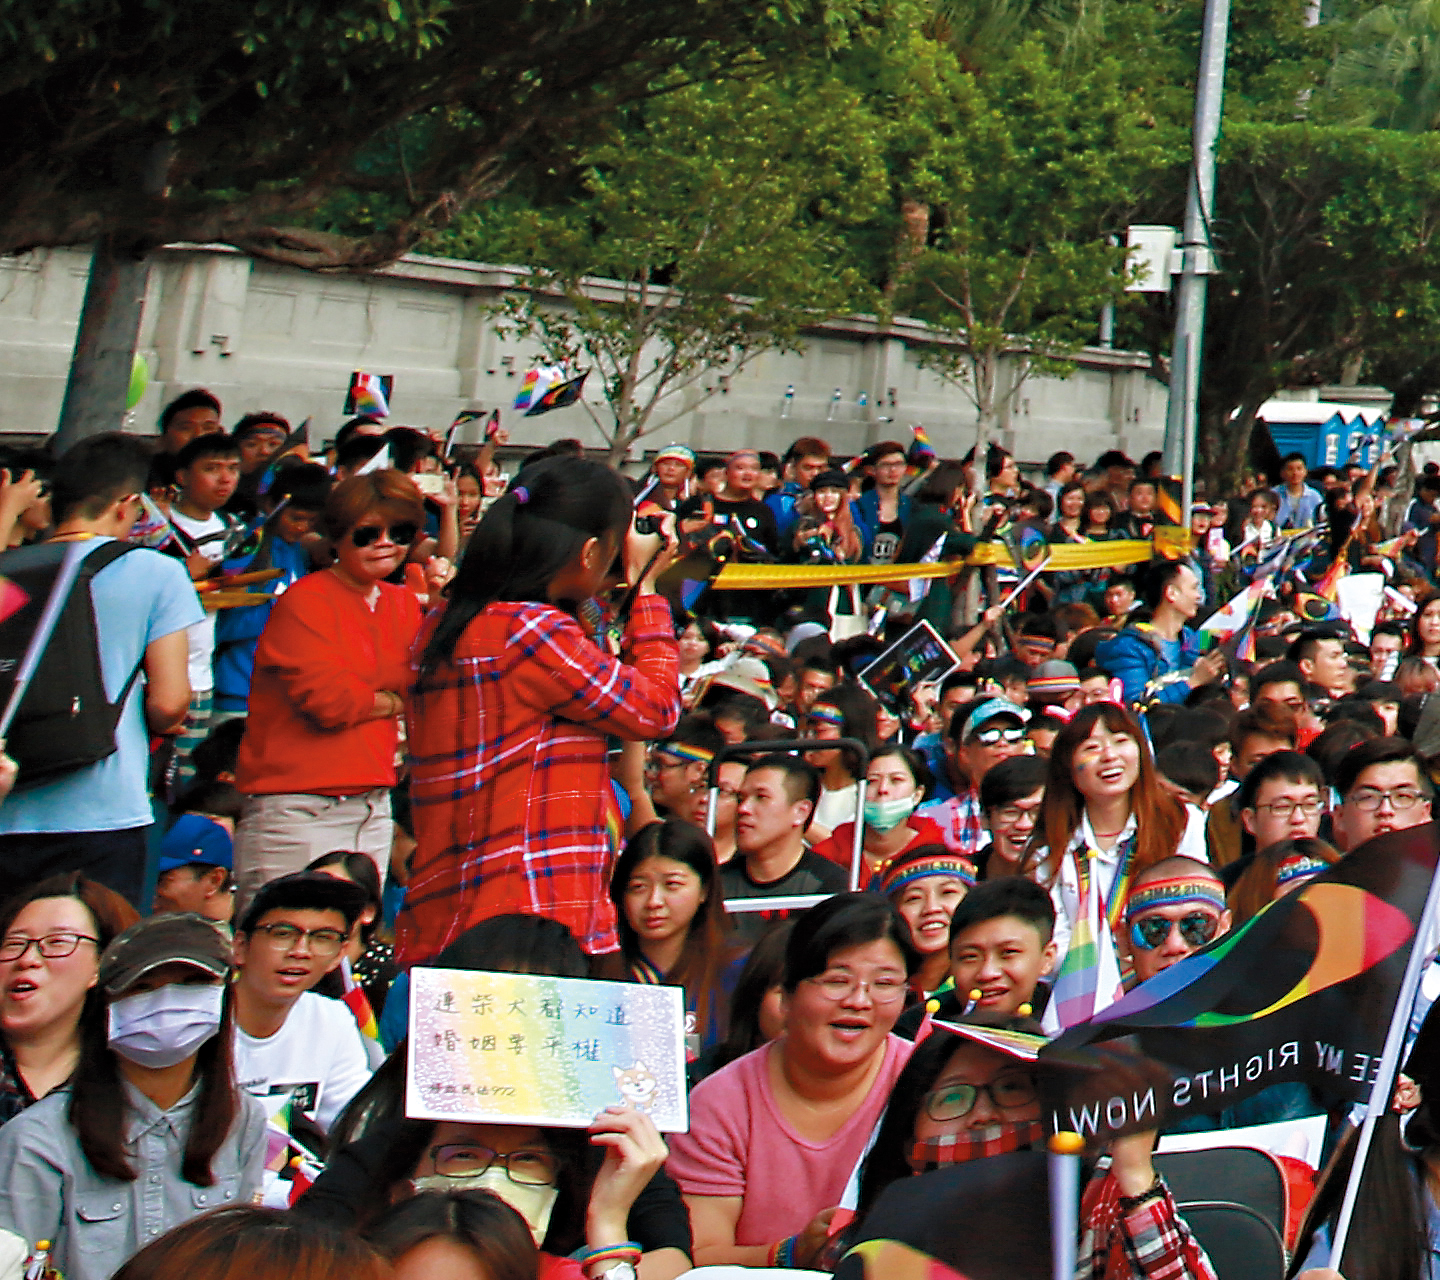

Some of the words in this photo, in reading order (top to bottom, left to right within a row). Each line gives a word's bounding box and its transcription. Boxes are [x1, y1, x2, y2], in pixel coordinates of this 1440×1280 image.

[433, 992, 633, 1026] 連柴犬都知道
[434, 1029, 601, 1062] 婚姻要平權
